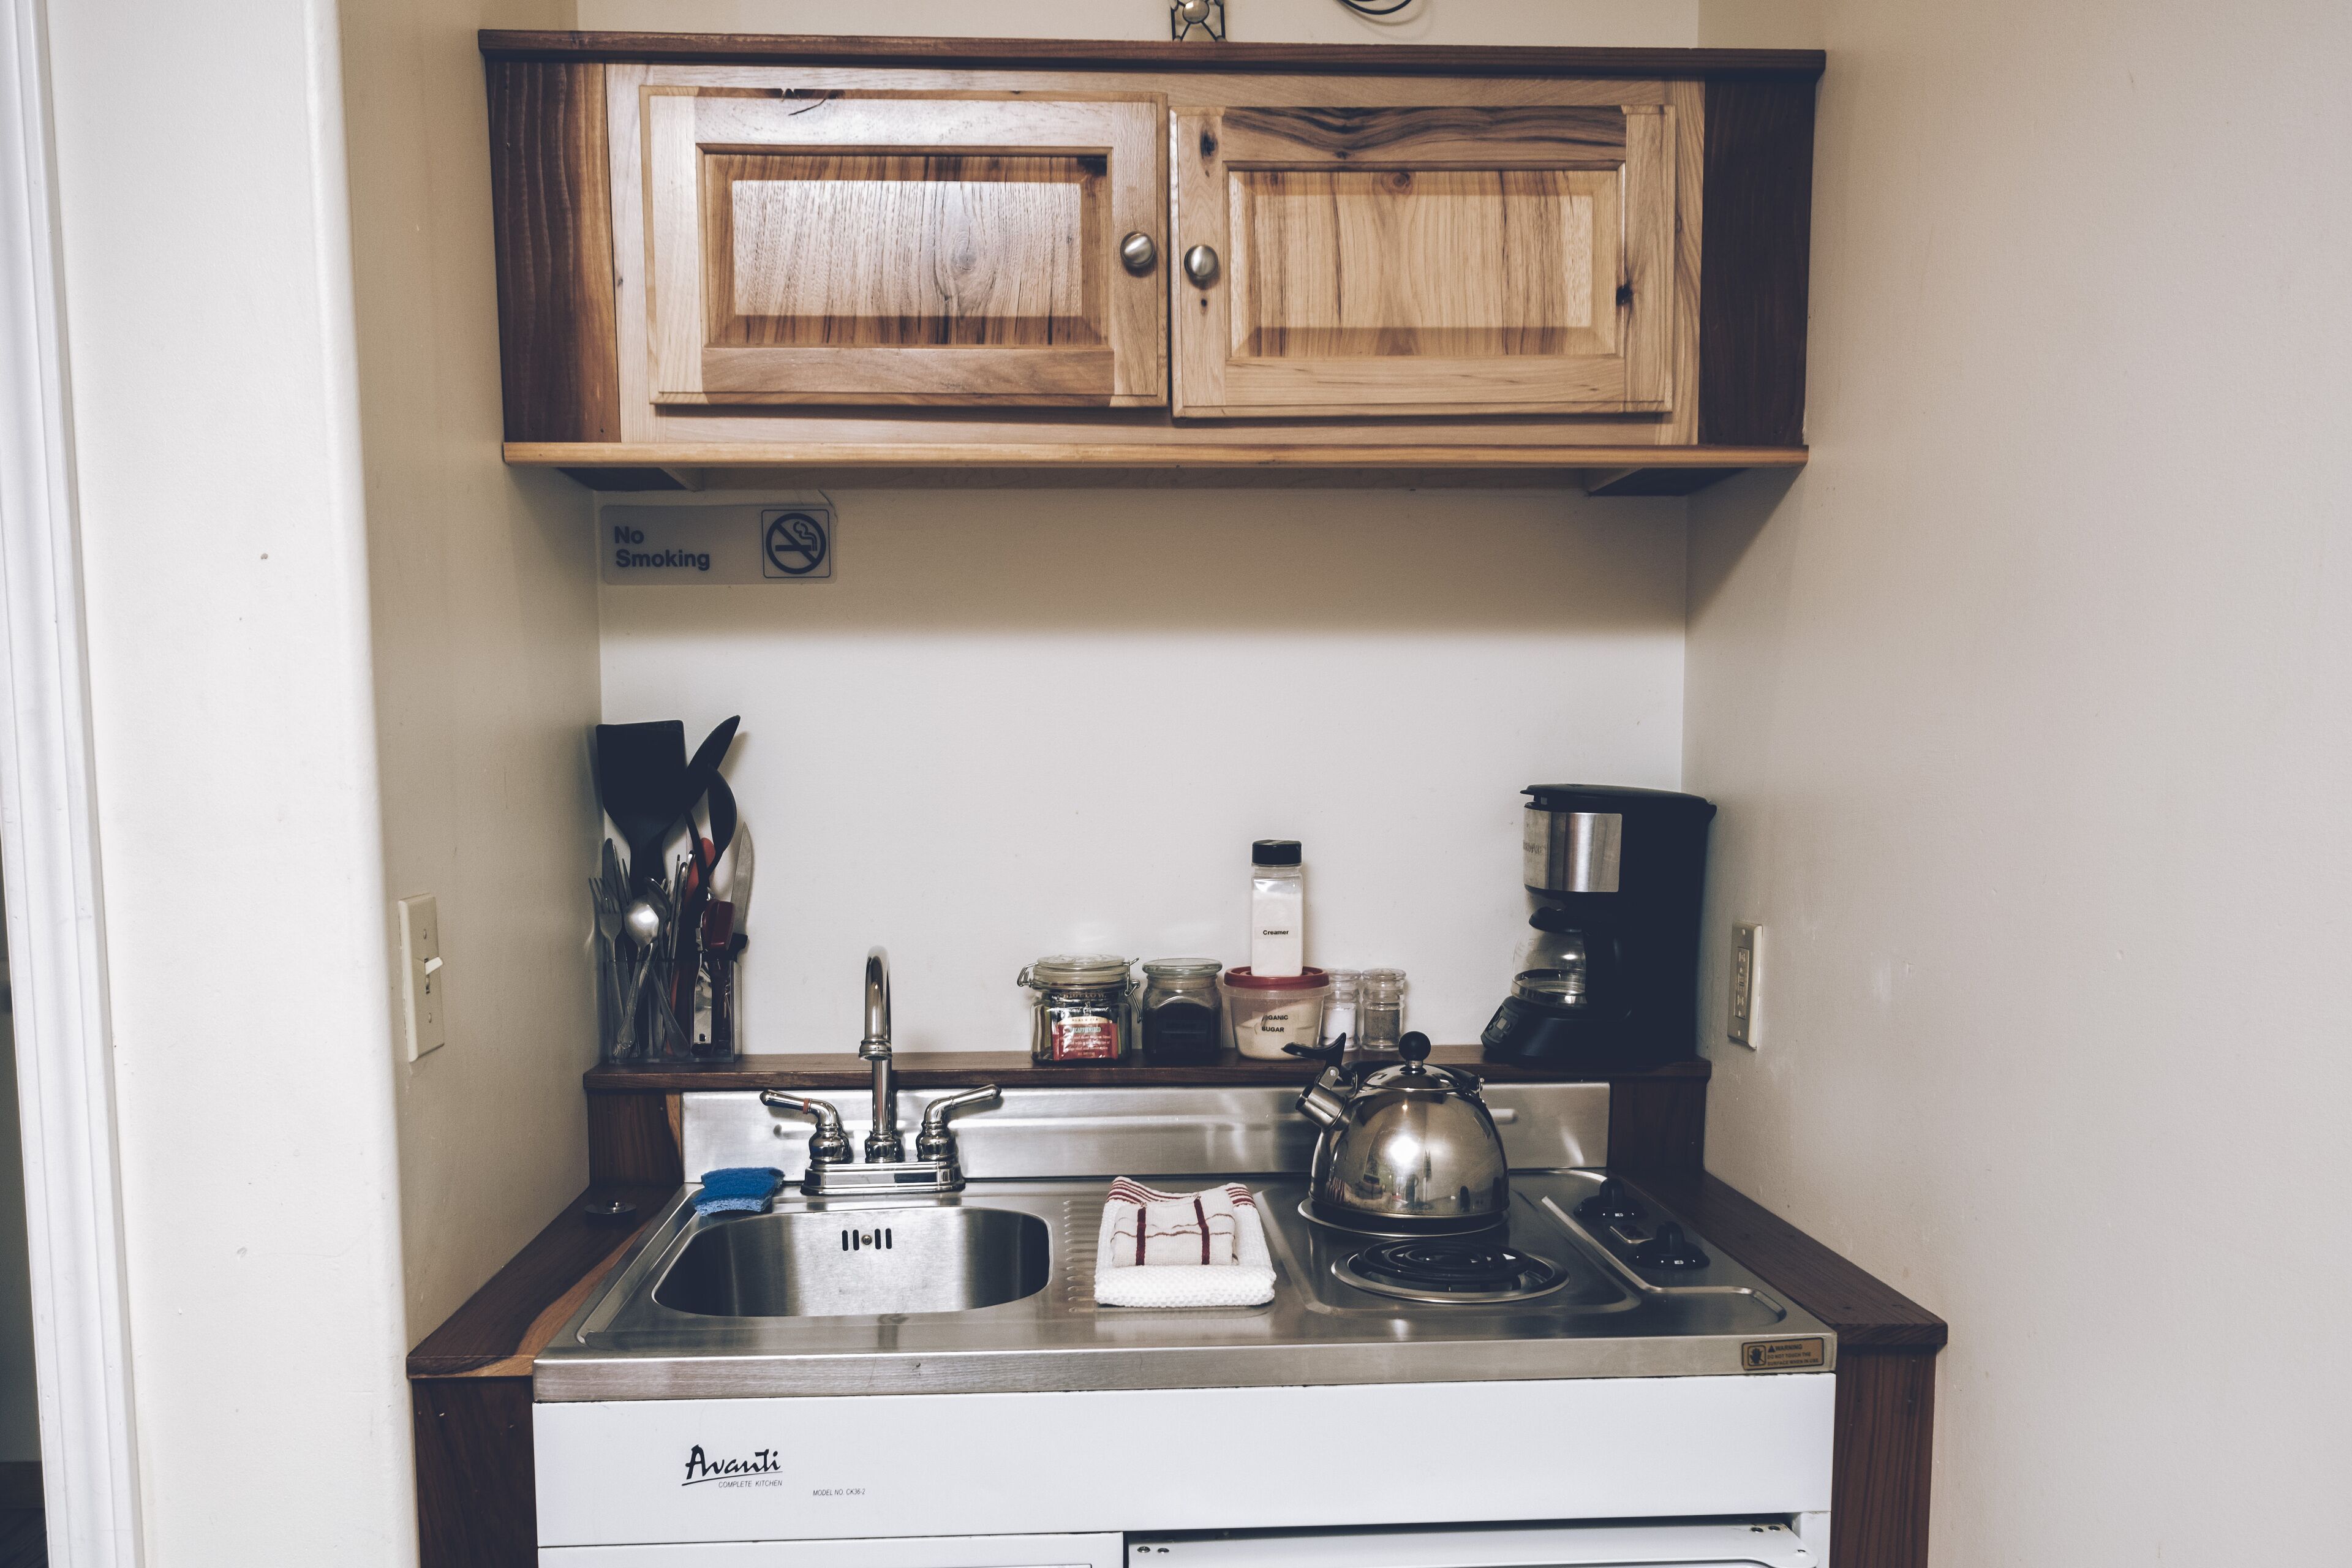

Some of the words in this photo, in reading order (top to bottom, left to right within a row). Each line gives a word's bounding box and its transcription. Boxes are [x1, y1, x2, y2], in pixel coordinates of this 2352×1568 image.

[614, 526, 644, 544] No
[616, 549, 710, 571] Smoking
[685, 1444, 781, 1480] Avanti
